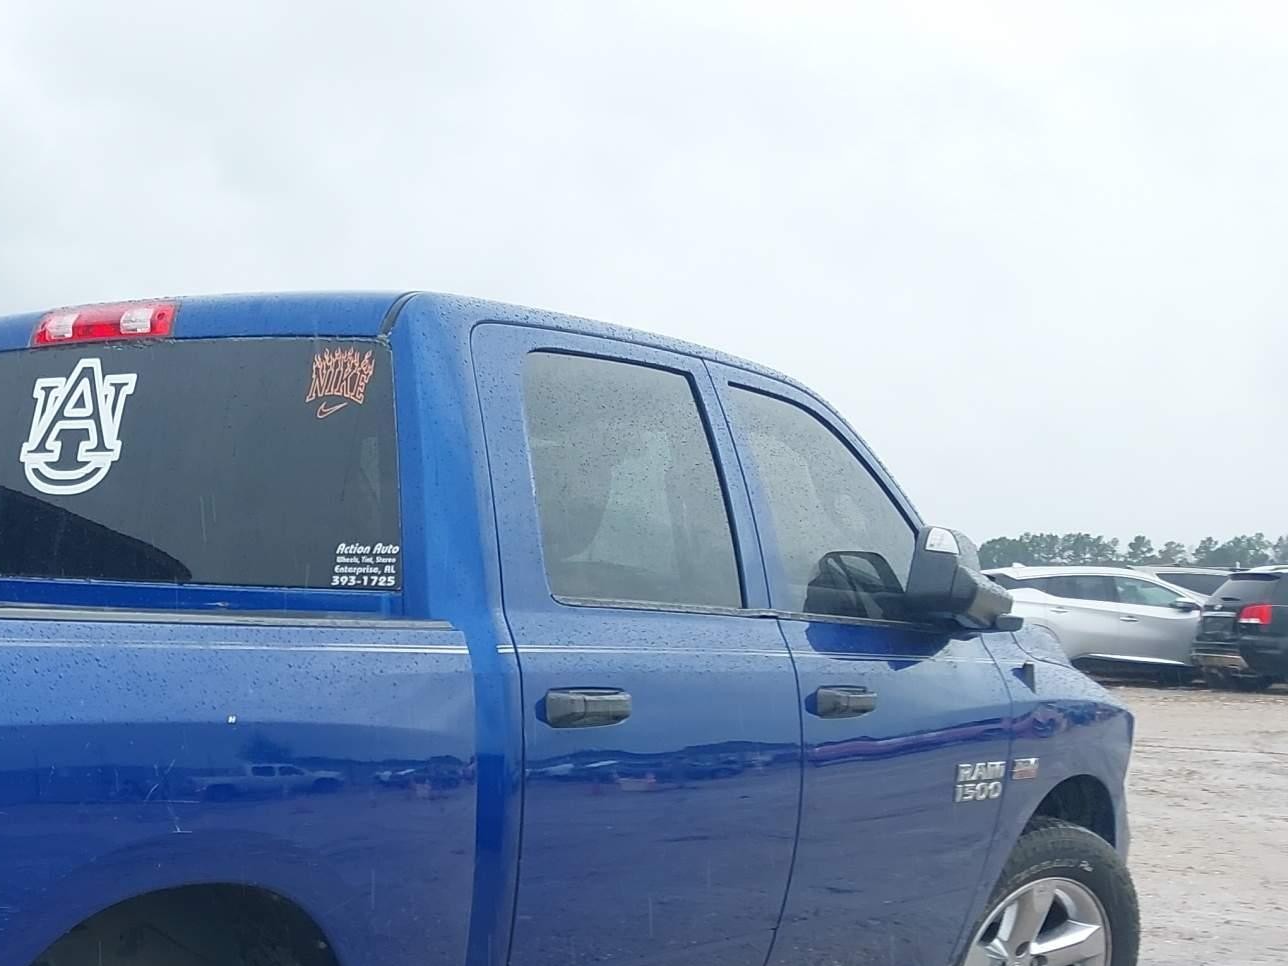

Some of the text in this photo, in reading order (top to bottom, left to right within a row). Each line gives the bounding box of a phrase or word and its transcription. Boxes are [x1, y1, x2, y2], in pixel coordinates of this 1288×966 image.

[305, 346, 375, 404] NIKE
[335, 542, 400, 555] Action Auto
[334, 565, 396, 576] Enterprise, AL
[331, 575, 396, 587] 393-1725
[957, 761, 1006, 781] RAM
[955, 782, 1002, 802] 1500
